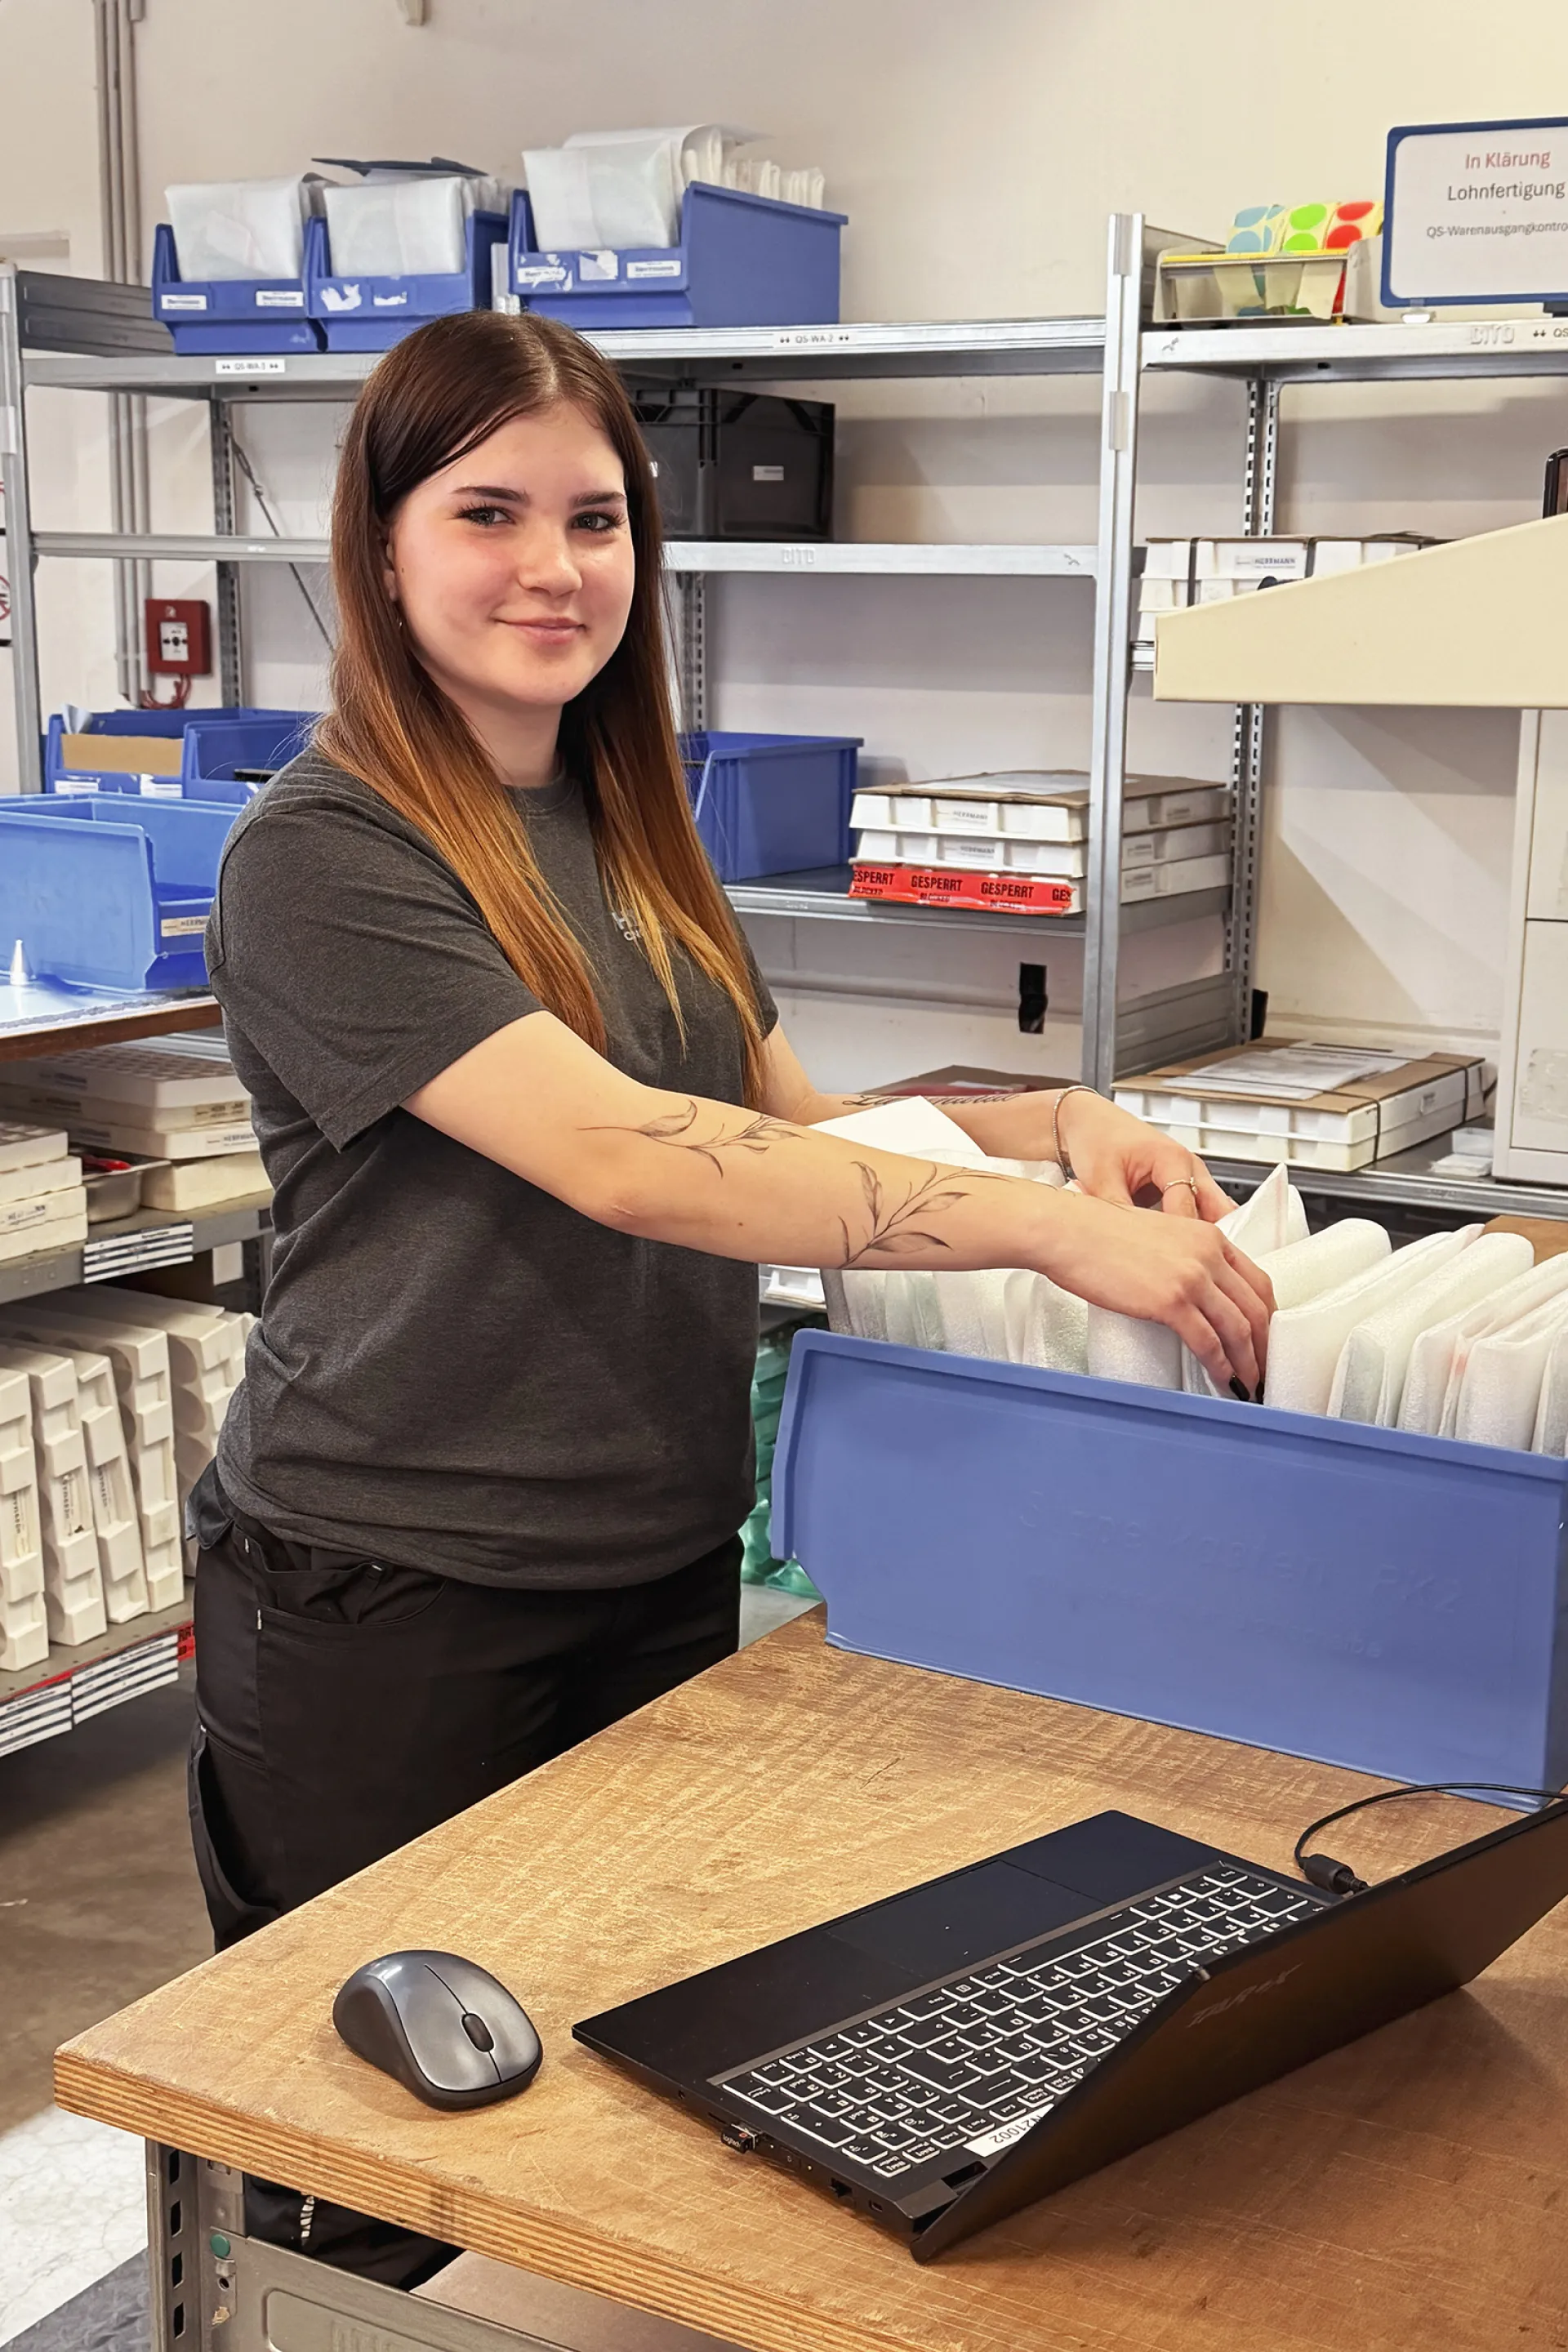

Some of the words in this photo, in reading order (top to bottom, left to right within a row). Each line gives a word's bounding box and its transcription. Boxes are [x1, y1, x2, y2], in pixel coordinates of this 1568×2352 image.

[1465, 154, 1481, 169] In
[1485, 150, 1551, 169] Klärung
[1448, 180, 1566, 201] Lohnfertigung
[911, 875, 963, 892] GESPERRT
[981, 881, 1034, 898] GESPERRT
